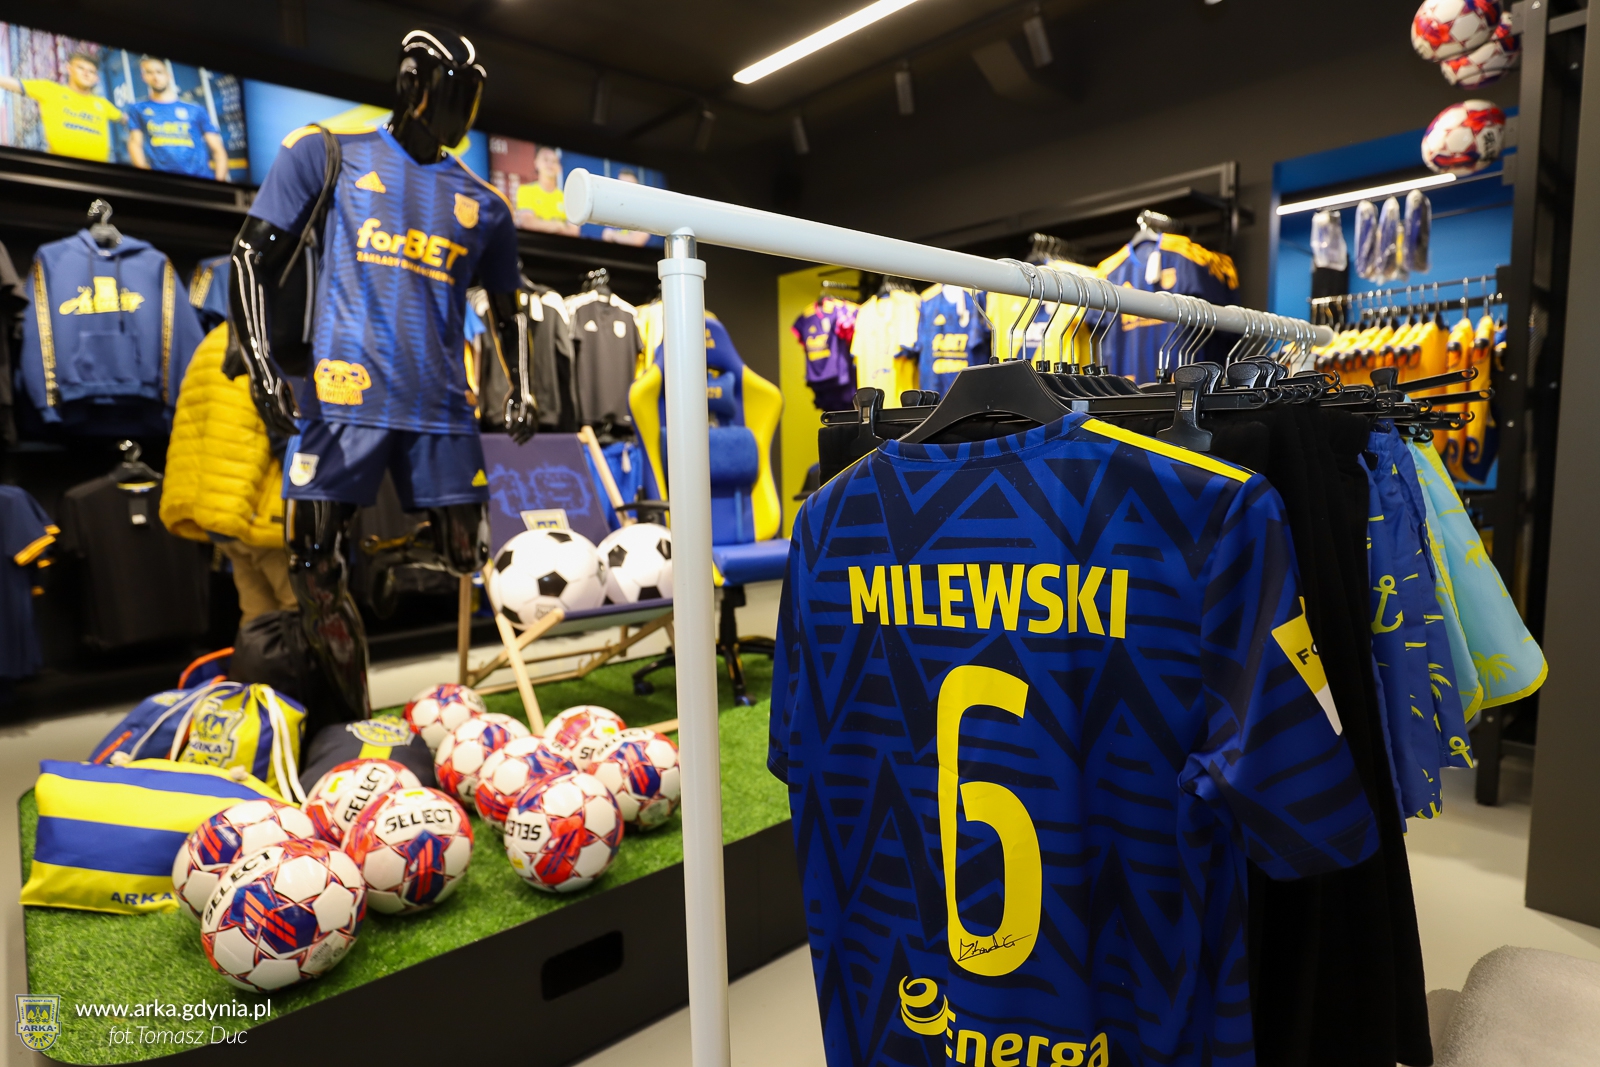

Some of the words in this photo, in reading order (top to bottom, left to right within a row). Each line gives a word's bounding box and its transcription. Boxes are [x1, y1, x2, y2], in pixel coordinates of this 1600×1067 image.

[356, 217, 469, 271] forBET
[848, 563, 1129, 639] MILEWSKI
[344, 767, 388, 823] SELECT
[385, 808, 454, 835] SELECT
[936, 664, 1043, 977] 6
[110, 891, 174, 905] ARKA
[205, 849, 271, 926] SELECT
